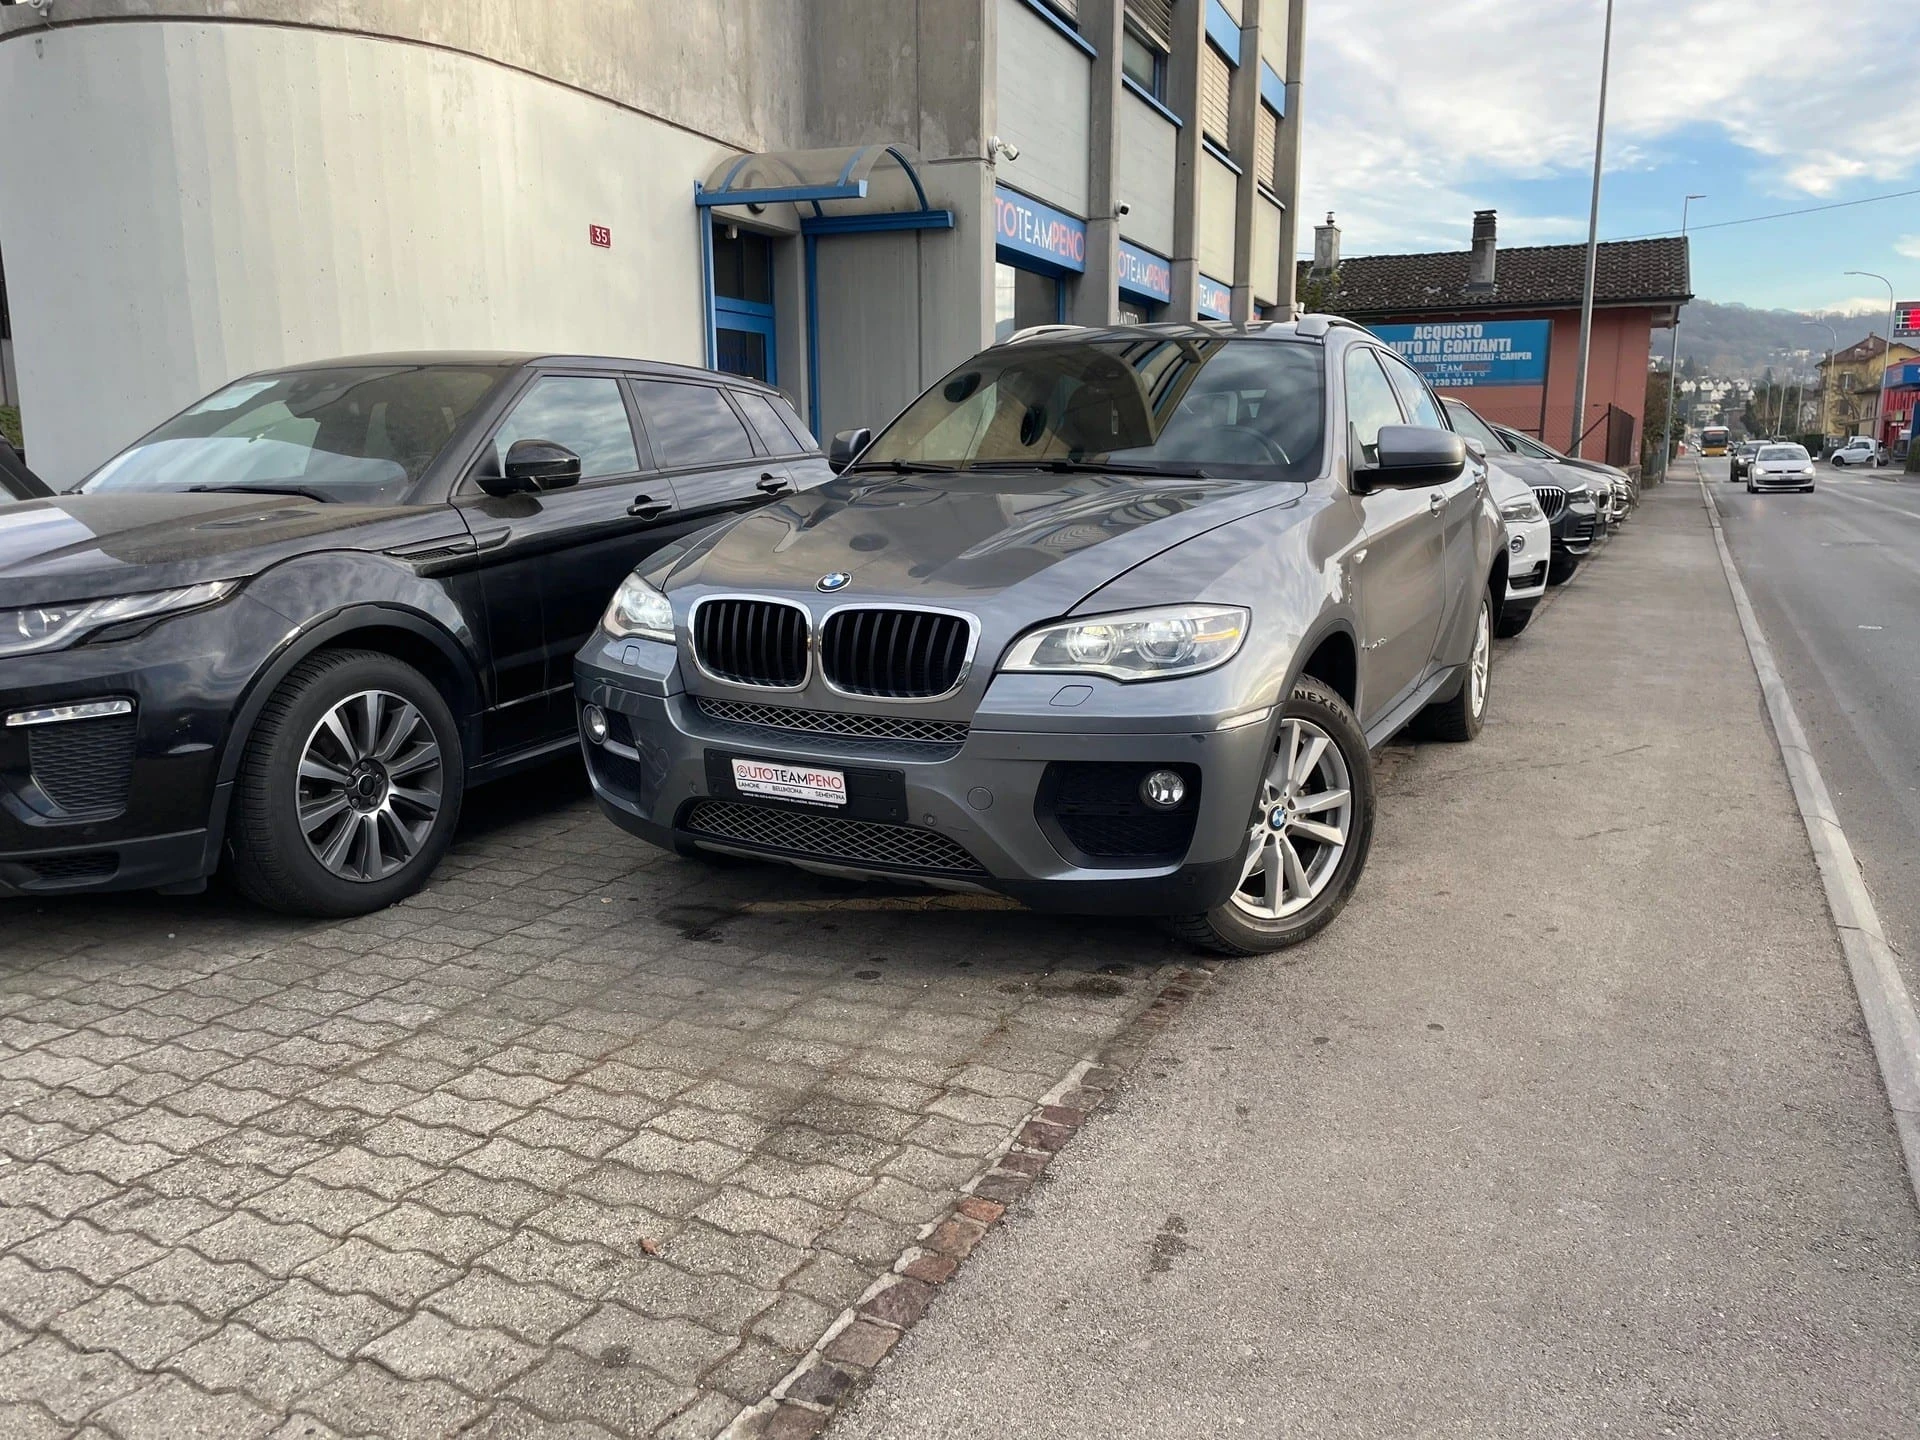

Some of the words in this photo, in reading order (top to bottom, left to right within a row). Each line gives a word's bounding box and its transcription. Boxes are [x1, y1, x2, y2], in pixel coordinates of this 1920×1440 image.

[595, 227, 608, 243] 35
[993, 196, 1084, 262] TOTEAMPENO
[1118, 249, 1169, 295] OTEAMPENO
[1414, 325, 1483, 340] ACQUISTO
[1426, 340, 1440, 353] IN
[1443, 338, 1511, 353] CONTANTI
[1413, 354, 1441, 362] VEICOLI
[1442, 353, 1494, 362] COMMERCIALI
[1295, 690, 1347, 723] NEXEN
[738, 781, 760, 790] LAMONE
